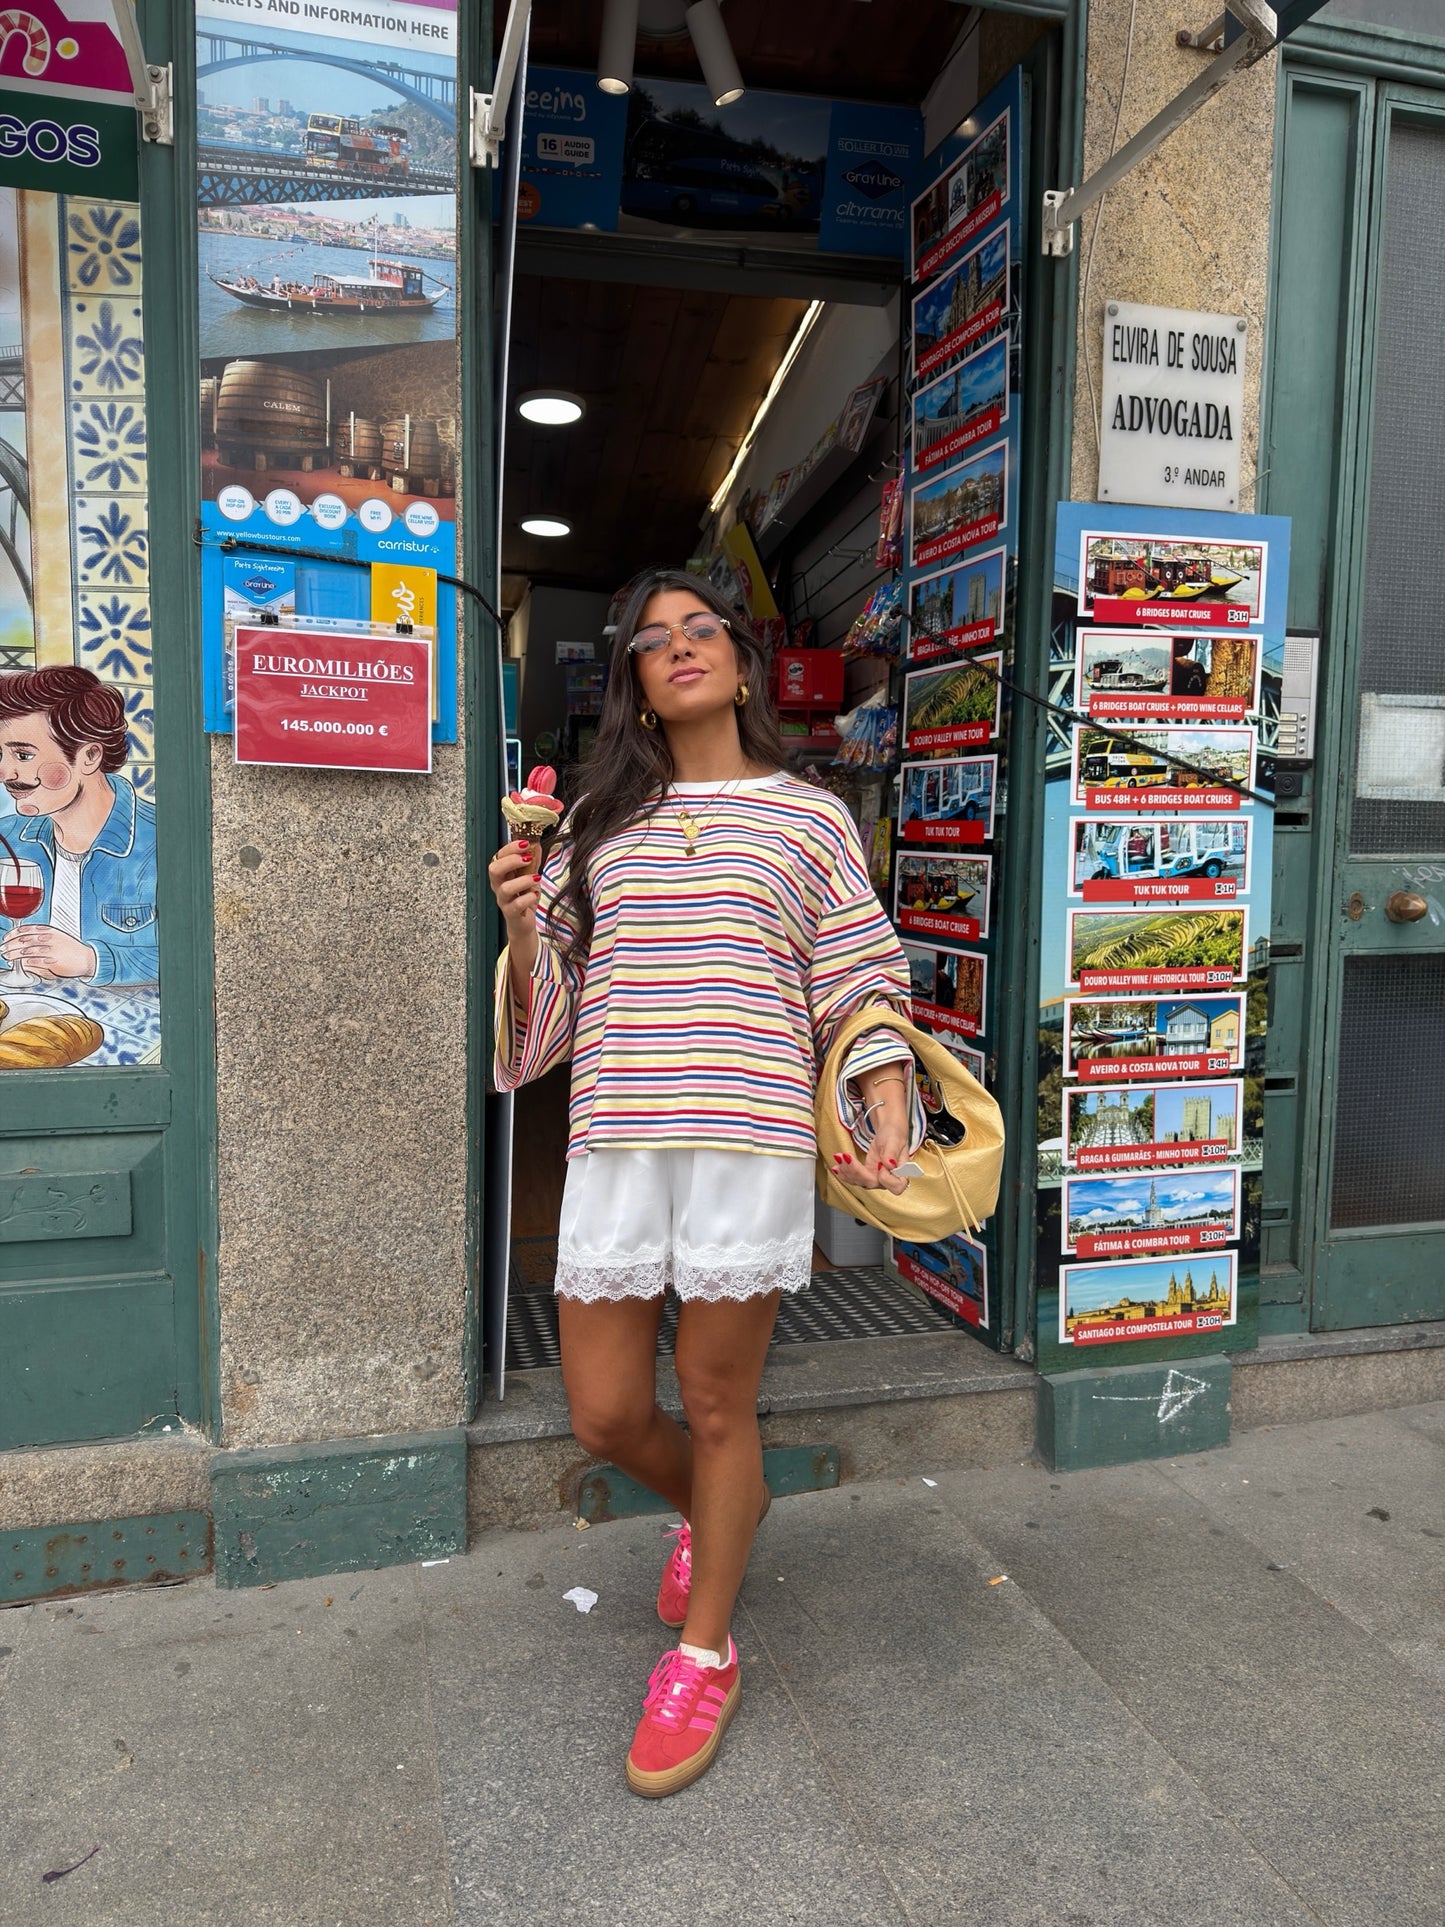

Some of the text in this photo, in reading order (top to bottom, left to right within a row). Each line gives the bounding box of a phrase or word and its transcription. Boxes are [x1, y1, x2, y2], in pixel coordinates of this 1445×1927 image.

[268, 0, 300, 14] AND
[304, 4, 407, 32] INFORMATION
[411, 21, 448, 40] HERE
[542, 138, 590, 150] 16 AUDIO
[838, 140, 878, 153] ROLLER
[564, 150, 590, 158] GUIDE
[846, 172, 901, 187] Gray Line
[922, 252, 938, 272] WORLD
[938, 246, 945, 259] OF
[945, 220, 974, 253] DISCOVERIES
[975, 200, 997, 226] MUSEUM
[920, 306, 1000, 372] SANTIAGO DE COMPOSTELA TOUR
[1112, 324, 1236, 374] ELVIRA DE SOUSA
[1112, 394, 1232, 441] ADVOGADA
[925, 419, 992, 466] FÁTIMA & COIMBRA TOUR
[1184, 468, 1225, 488] ANDAR
[217, 530, 300, 542] www.yellowbustours.com
[943, 536, 961, 552] COSTA
[962, 528, 980, 544] NOVA
[980, 520, 996, 536] TOUR
[378, 540, 430, 552] carristur
[1136, 608, 1211, 619] 6 BRIDGES BOAT CRUISE
[1237, 612, 1247, 621] 1H
[961, 630, 977, 643] MINHO
[978, 627, 990, 639] TOUR
[252, 654, 414, 681] EUROMILHÕES
[301, 684, 368, 698] JACKPOT
[1093, 702, 1098, 710] 6
[1099, 702, 1127, 711] BRIDGES
[1129, 703, 1145, 711] BOAT
[1146, 703, 1170, 712] CRUISE
[1177, 703, 1198, 712] PORTO
[1199, 704, 1216, 712] WINE
[1217, 704, 1242, 712] CELLARS
[281, 719, 388, 736] 145.000.000 €
[914, 728, 983, 746] DOURO VALLEY WINE TOUR
[1095, 795, 1111, 804] BUS
[1113, 795, 1130, 804] 48H
[1141, 795, 1146, 804] 6
[1148, 795, 1182, 804] BRIDGES
[1184, 795, 1205, 804] BOAT
[1206, 795, 1233, 804] CRUISE
[925, 827, 960, 837] TUK TUK TOUR
[1134, 885, 1189, 895] TUK TUK TOUR
[1224, 884, 1234, 893] 1H
[913, 917, 934, 929] BRIDGES
[934, 919, 950, 931] BOAT
[951, 921, 970, 934] CRUISE
[1084, 977, 1107, 986] DOURO
[1108, 976, 1131, 985] VALLEY
[1132, 975, 1148, 984] WINE
[1153, 973, 1188, 983] HISTORICAL
[1189, 973, 1205, 982] TOUR
[1215, 973, 1231, 981] 10H
[1090, 1061, 1200, 1074] AVEIRO & COSTA NOVA TOUR
[1216, 1060, 1227, 1068] 4H
[1080, 1155, 1104, 1164] BRAGA
[1105, 1154, 1110, 1162] &
[1112, 1150, 1151, 1162] GUIMARÃES
[1156, 1149, 1180, 1159] MINHO
[1181, 1148, 1199, 1157] TOUR
[1210, 1146, 1225, 1155] 10H
[1209, 1231, 1224, 1240] 10H
[1094, 1236, 1190, 1251] FÁTIMA & COIMBRA TOUR
[1204, 1317, 1220, 1325] 10H
[1078, 1320, 1192, 1340] SANTIAGO DE COMPOSTELA TOUR
